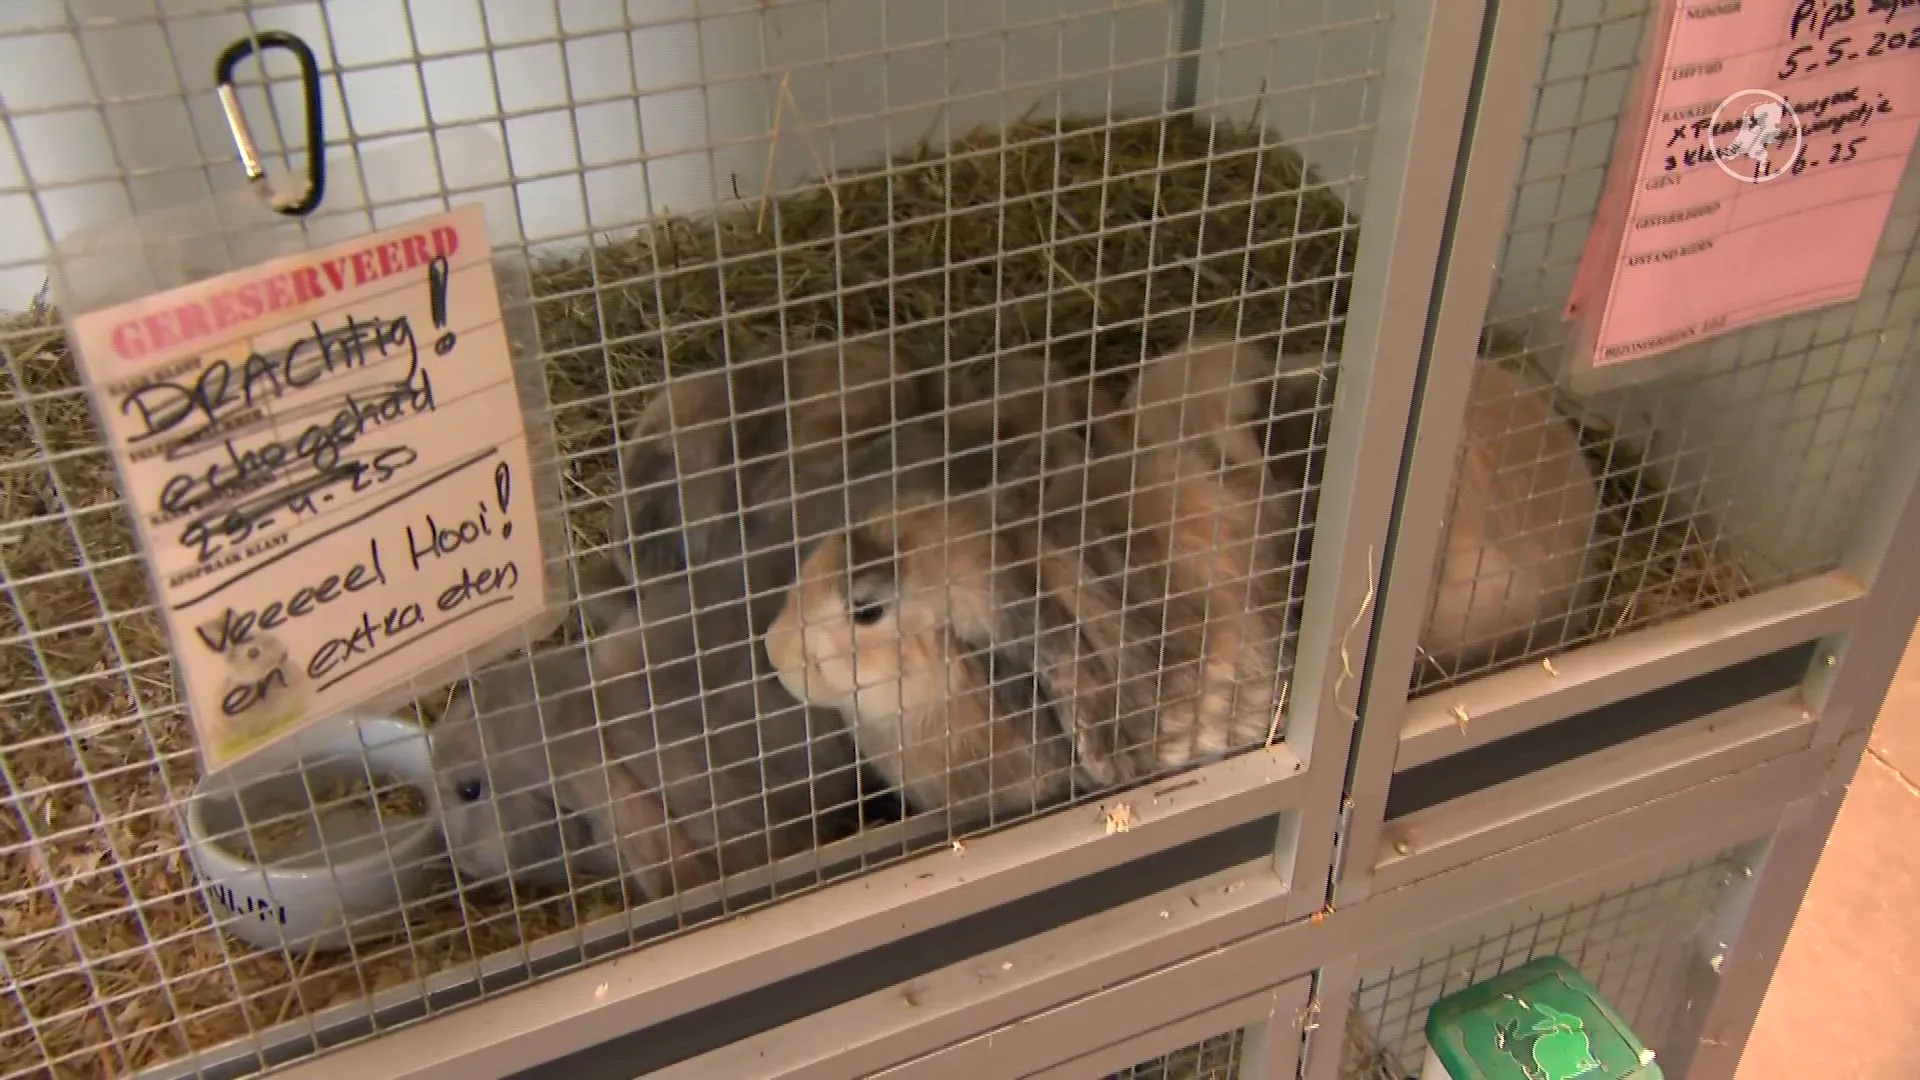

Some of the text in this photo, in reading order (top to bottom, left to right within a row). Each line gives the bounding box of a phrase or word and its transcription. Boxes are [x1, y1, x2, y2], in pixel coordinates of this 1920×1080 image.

[112, 226, 460, 360] GERESERVEERD
[221, 667, 289, 716] en
[306, 603, 426, 679] extra
